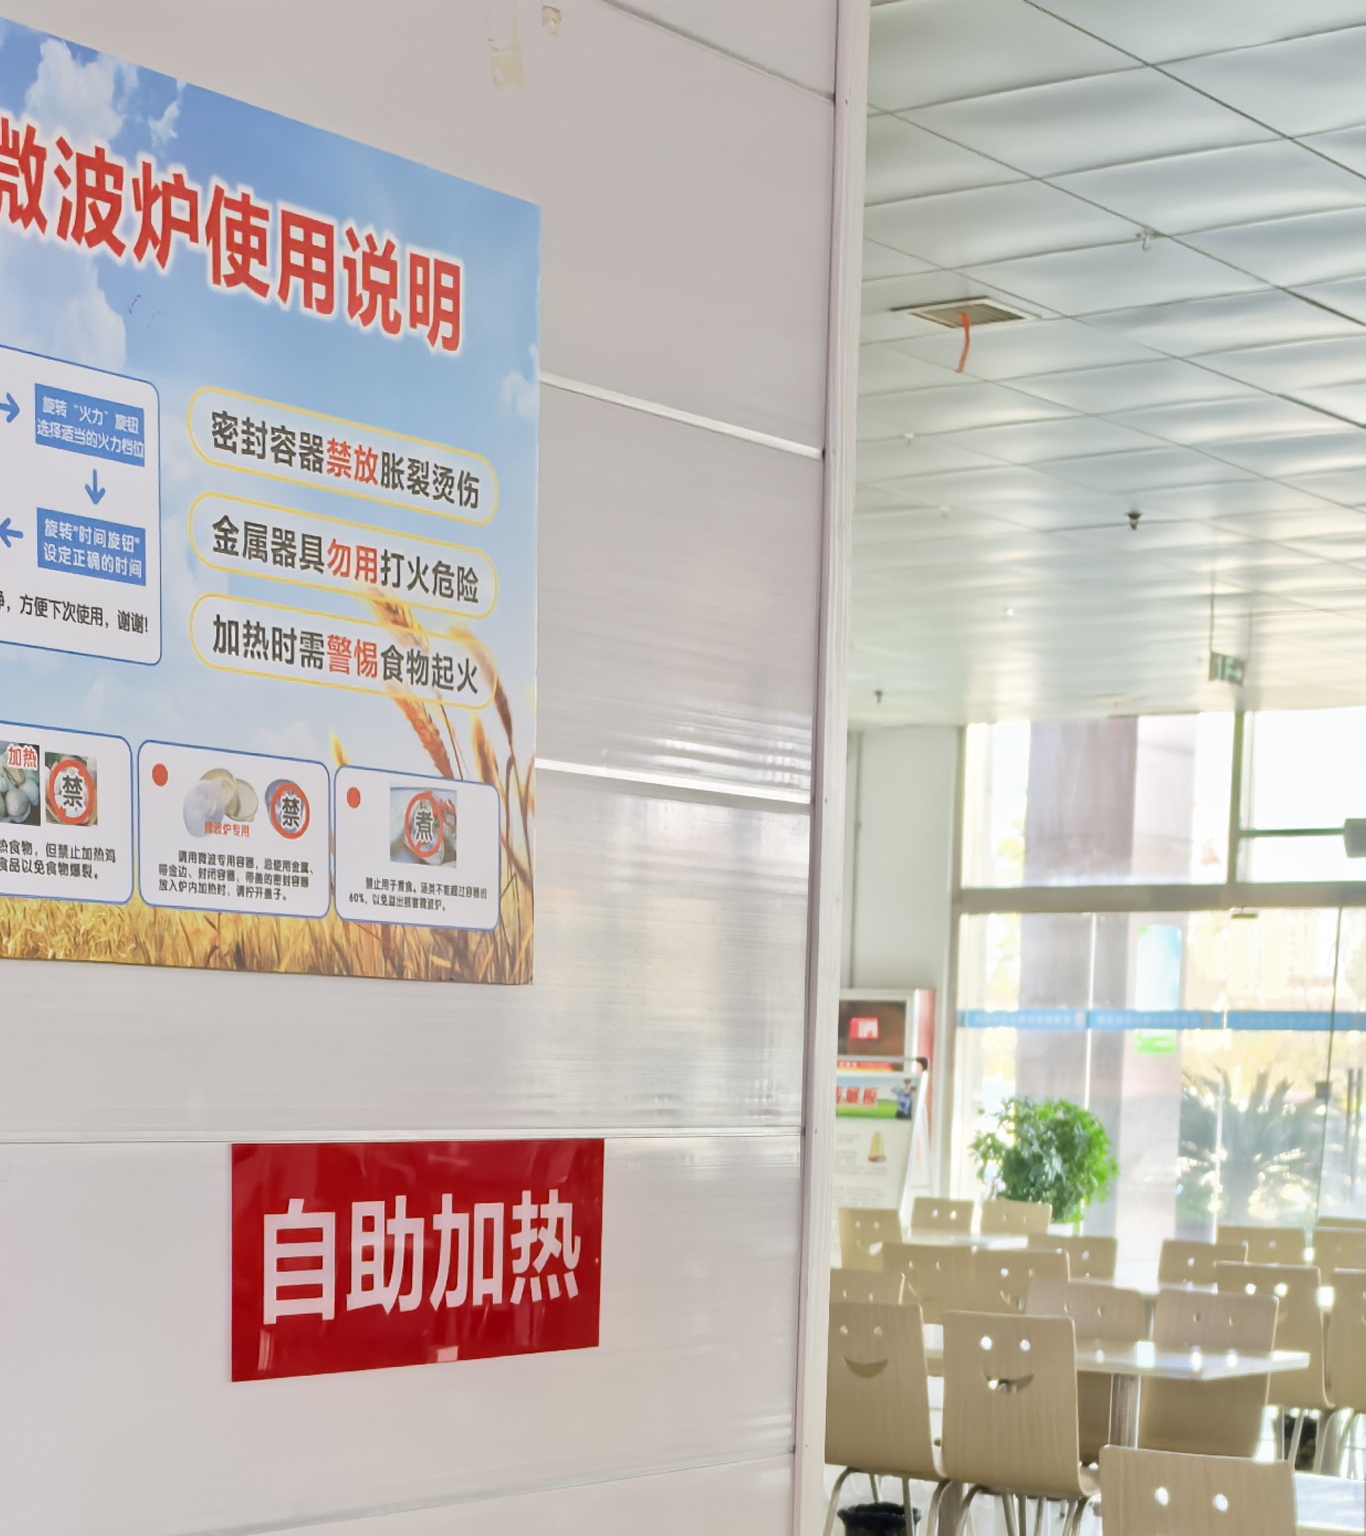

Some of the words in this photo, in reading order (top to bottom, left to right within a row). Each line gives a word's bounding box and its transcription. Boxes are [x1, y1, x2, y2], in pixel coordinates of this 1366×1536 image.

[36, 417, 145, 459] 选择适当的火力档位
[211, 410, 480, 510] 密封容器禁放胀裂烫伤
[43, 541, 143, 579] 设定正确的时间
[212, 515, 479, 603] 金属器具勿用打火危险
[212, 614, 478, 695] 加热时需警惕食物起火
[8, 747, 37, 768] 加热
[62, 774, 83, 811] 禁
[415, 811, 433, 842] 煮
[261, 1189, 582, 1325] 自助加热
